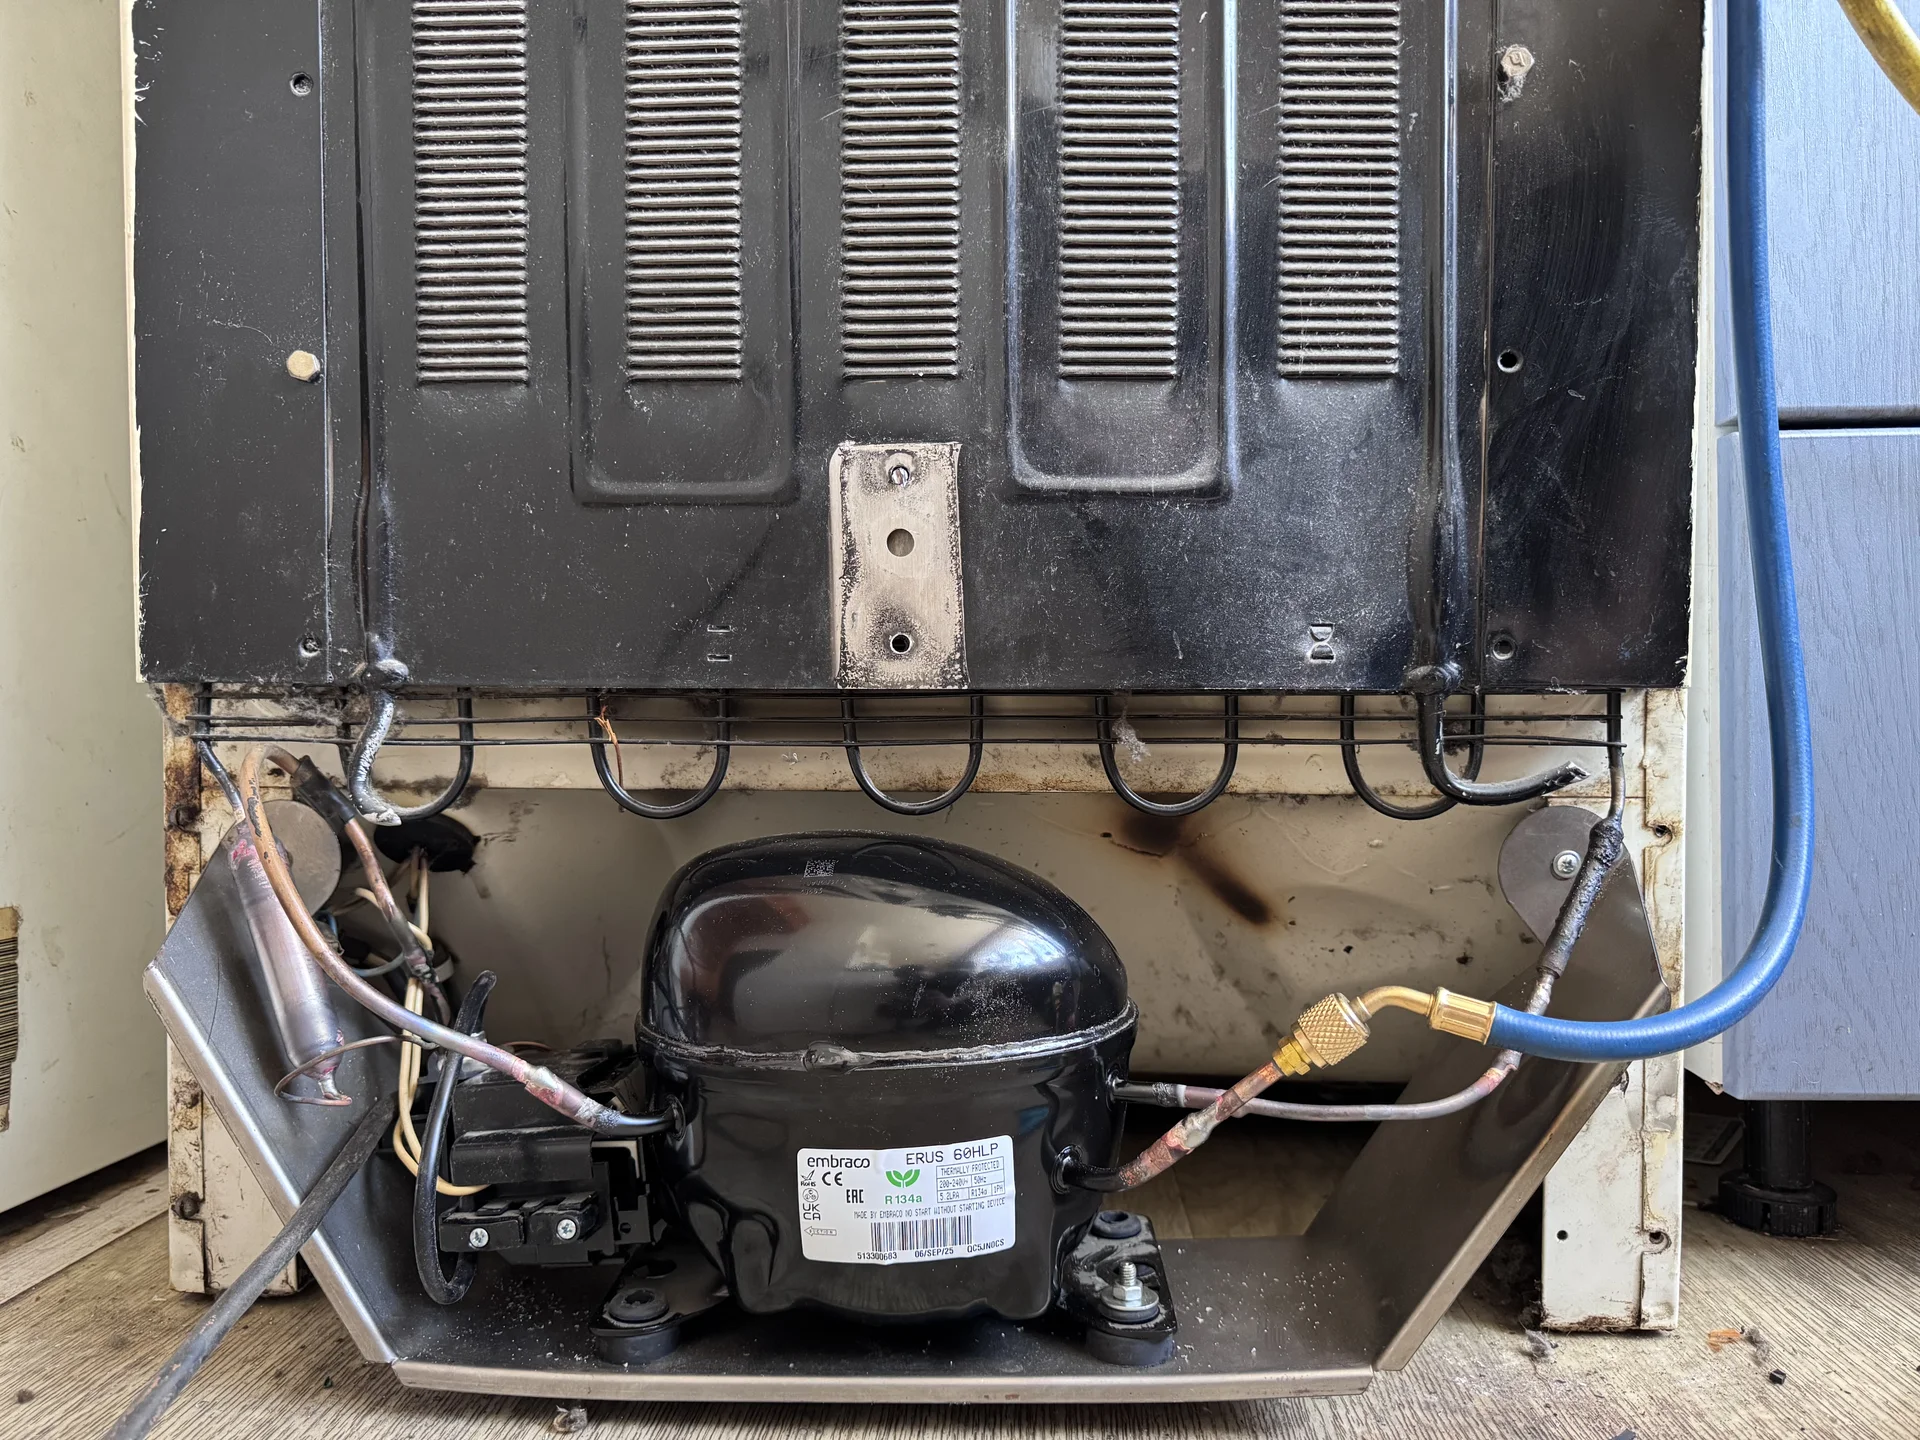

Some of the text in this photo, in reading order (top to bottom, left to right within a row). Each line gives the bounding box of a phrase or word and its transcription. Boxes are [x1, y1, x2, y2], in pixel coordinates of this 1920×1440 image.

[906, 1142, 999, 1165] ERUS 60HLP
[807, 1154, 871, 1169] embraco
[940, 1159, 1000, 1176] THERMALLY PROTECTED
[821, 1171, 843, 1186] CE
[846, 1188, 864, 1203] EAC
[802, 1203, 820, 1212] UK
[854, 1197, 1006, 1219] MADE BY EMBRACO NO START WITHOUT STARTING DEVICE
[803, 1212, 821, 1221] CA
[857, 1251, 898, 1261] 513300683
[914, 1247, 954, 1258] 06/SEP/25
